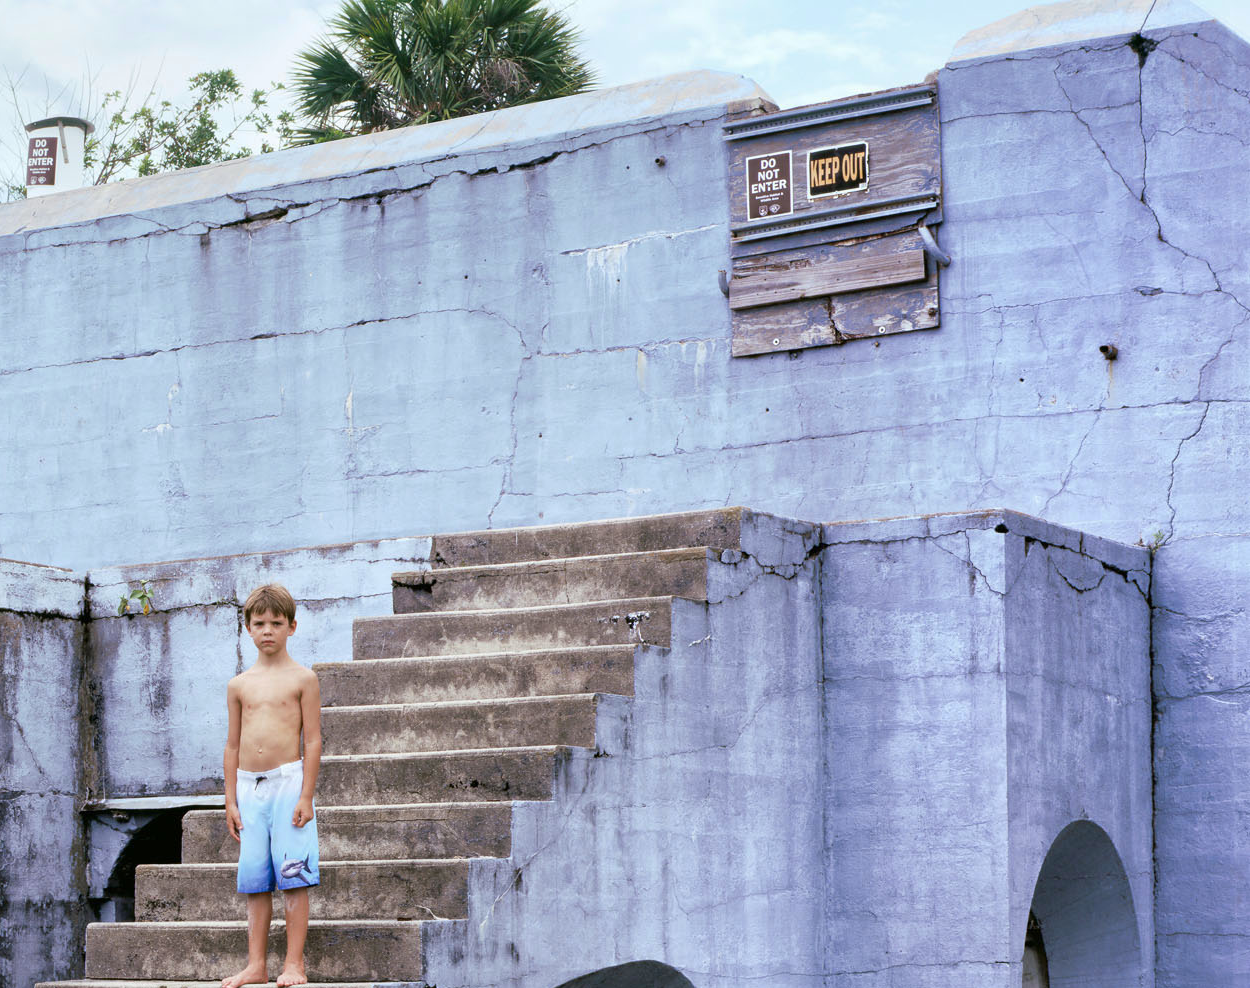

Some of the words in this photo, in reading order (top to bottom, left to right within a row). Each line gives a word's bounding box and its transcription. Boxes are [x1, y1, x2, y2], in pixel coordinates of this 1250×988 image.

[35, 139, 47, 148] DO
[32, 148, 49, 157] NOT
[28, 157, 53, 167] ENTER
[760, 158, 776, 170] DO
[757, 168, 780, 182] NOT
[810, 156, 840, 188] KEEP
[841, 151, 865, 182] OUT
[751, 179, 787, 194] ENTER
